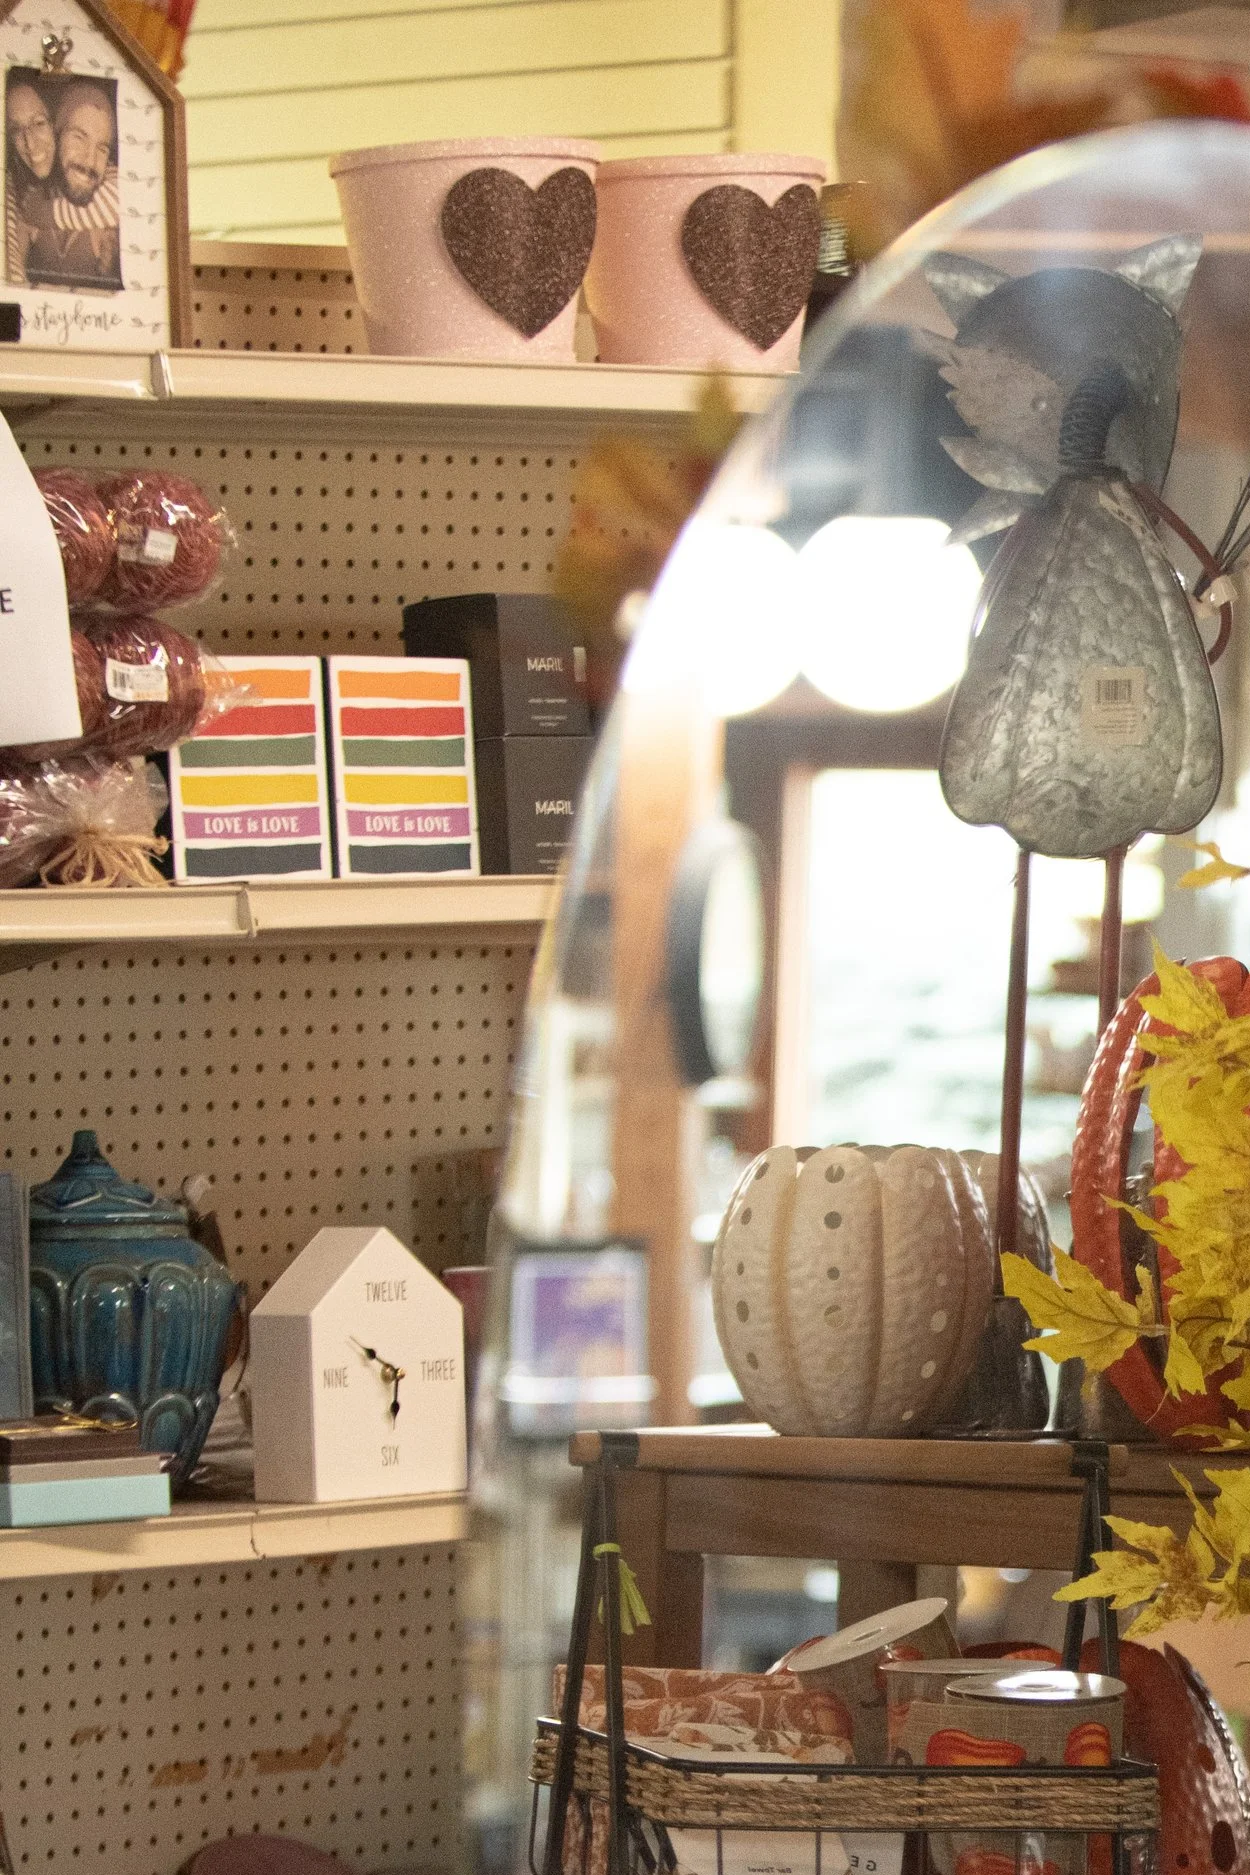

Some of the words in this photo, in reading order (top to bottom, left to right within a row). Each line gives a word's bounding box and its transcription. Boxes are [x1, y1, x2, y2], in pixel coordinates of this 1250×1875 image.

[203, 816, 243, 834] LOVE
[247, 815, 258, 833] is
[261, 816, 300, 833] LOVE
[365, 815, 401, 832] LOVE
[404, 816, 414, 832] is
[417, 815, 452, 832] LOVE
[364, 1280, 408, 1302] TWELVE
[323, 1367, 350, 1389] NINE
[420, 1359, 457, 1382] THREE
[381, 1445, 400, 1466] SIX
